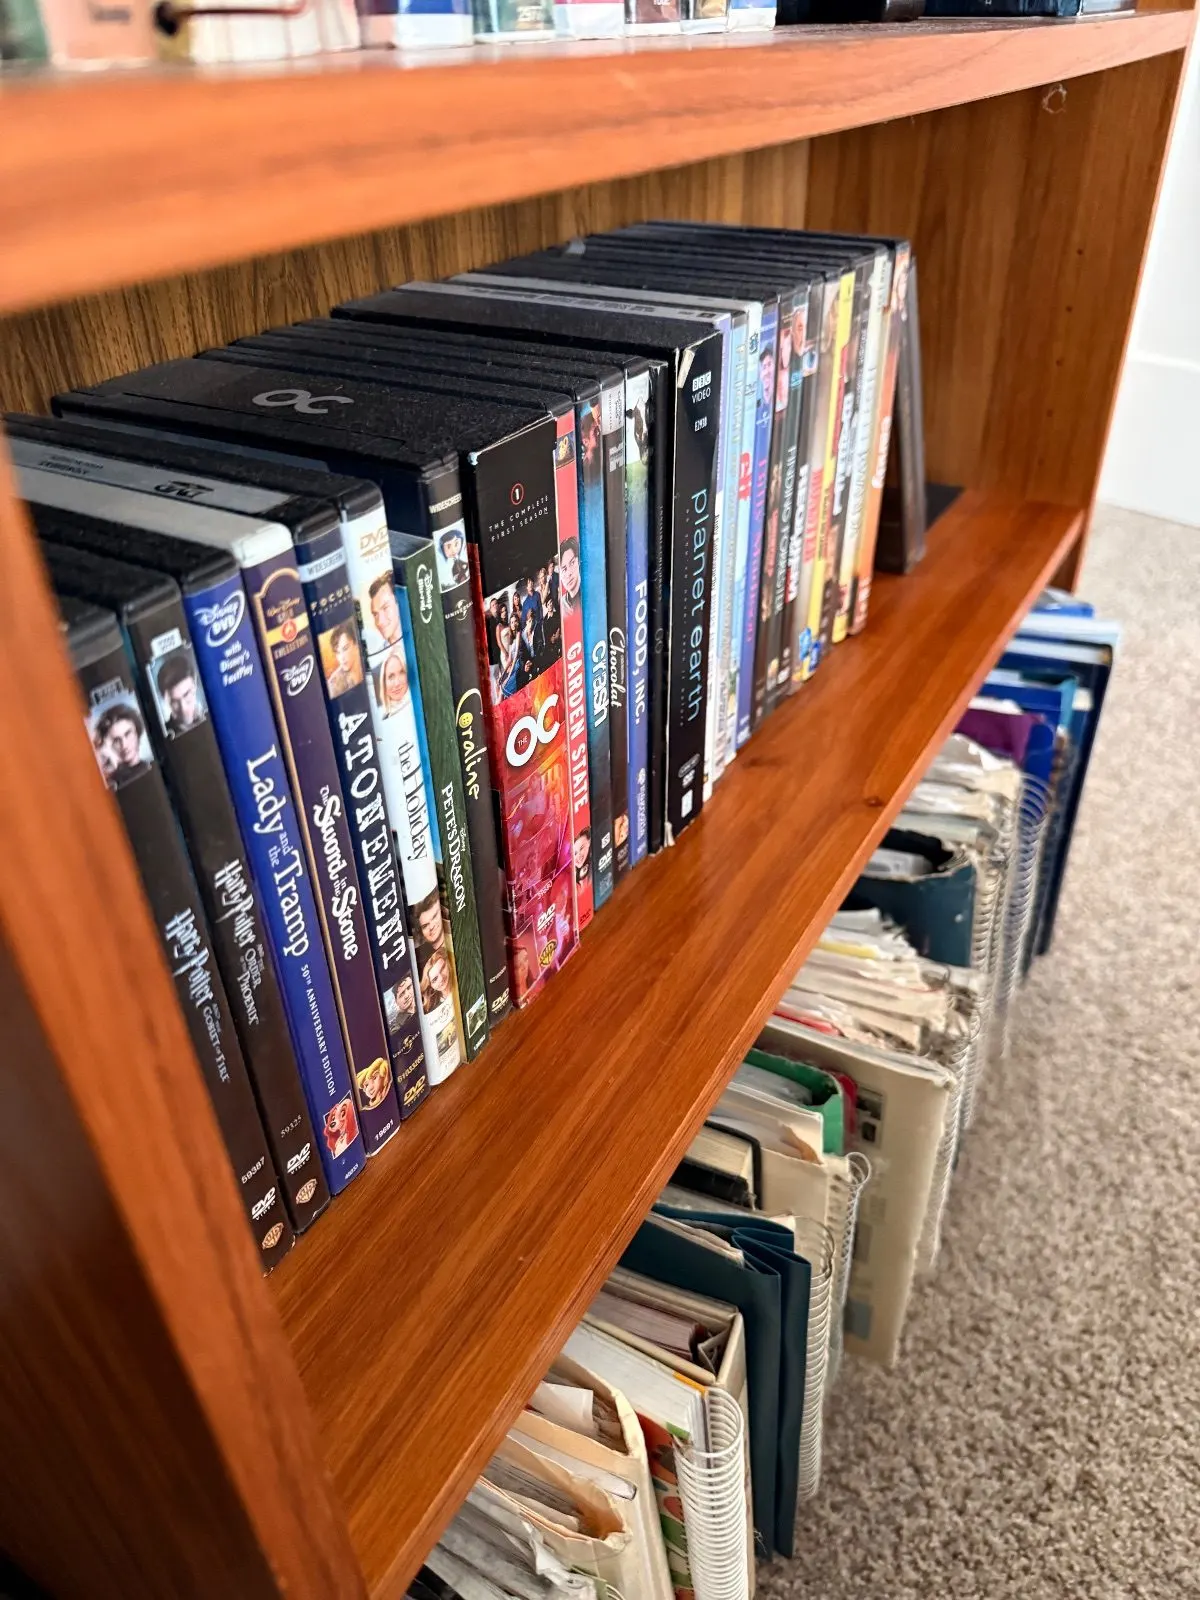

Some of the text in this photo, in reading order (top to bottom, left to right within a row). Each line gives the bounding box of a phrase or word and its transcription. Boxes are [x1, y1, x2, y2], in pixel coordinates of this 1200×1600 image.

[691, 387, 711, 403] VIDEO
[692, 371, 712, 392] BBC
[429, 493, 462, 514] WIDESCREEN
[514, 488, 520, 501] 1
[488, 495, 549, 532] THE COMPLETE
[491, 506, 549, 543] FIRST SEASON
[360, 524, 389, 557] DVD
[308, 552, 343, 576] WIDESCREEN
[309, 584, 351, 611] FOCUS
[445, 601, 473, 620] UNIVERSAL
[688, 488, 710, 722] planet earth
[210, 614, 236, 636] DVD
[224, 640, 242, 657] with
[632, 579, 648, 724] FOOD, INC.
[592, 640, 609, 728] crash
[609, 627, 626, 708] Chocolat
[455, 687, 488, 801] Coraline
[506, 693, 560, 767] OC
[517, 734, 529, 747] THE
[567, 641, 588, 814] GARDEN STATE
[397, 739, 429, 861] the Holiday
[246, 744, 310, 958] Lady and the Tramp
[339, 711, 407, 970] ATONEMENT
[313, 794, 348, 880] Sword
[331, 885, 359, 961] Stone
[448, 839, 466, 913] DRAGON
[214, 858, 257, 948] Harry Potter
[537, 903, 556, 931] DVD
[165, 907, 214, 1009] Harry Potter
[244, 948, 262, 990] ORDER
[237, 971, 257, 1025] PHOENIX
[491, 987, 510, 1012] DVD
[203, 1006, 220, 1048] GOBLET
[216, 1052, 229, 1083] FIRE
[300, 964, 336, 1097] 50TH ANNIVERSARY EDITION
[403, 1075, 426, 1106] DVD
[241, 1156, 265, 1184] 59387
[287, 1142, 311, 1173] DVD
[251, 1187, 276, 1218] DVD
